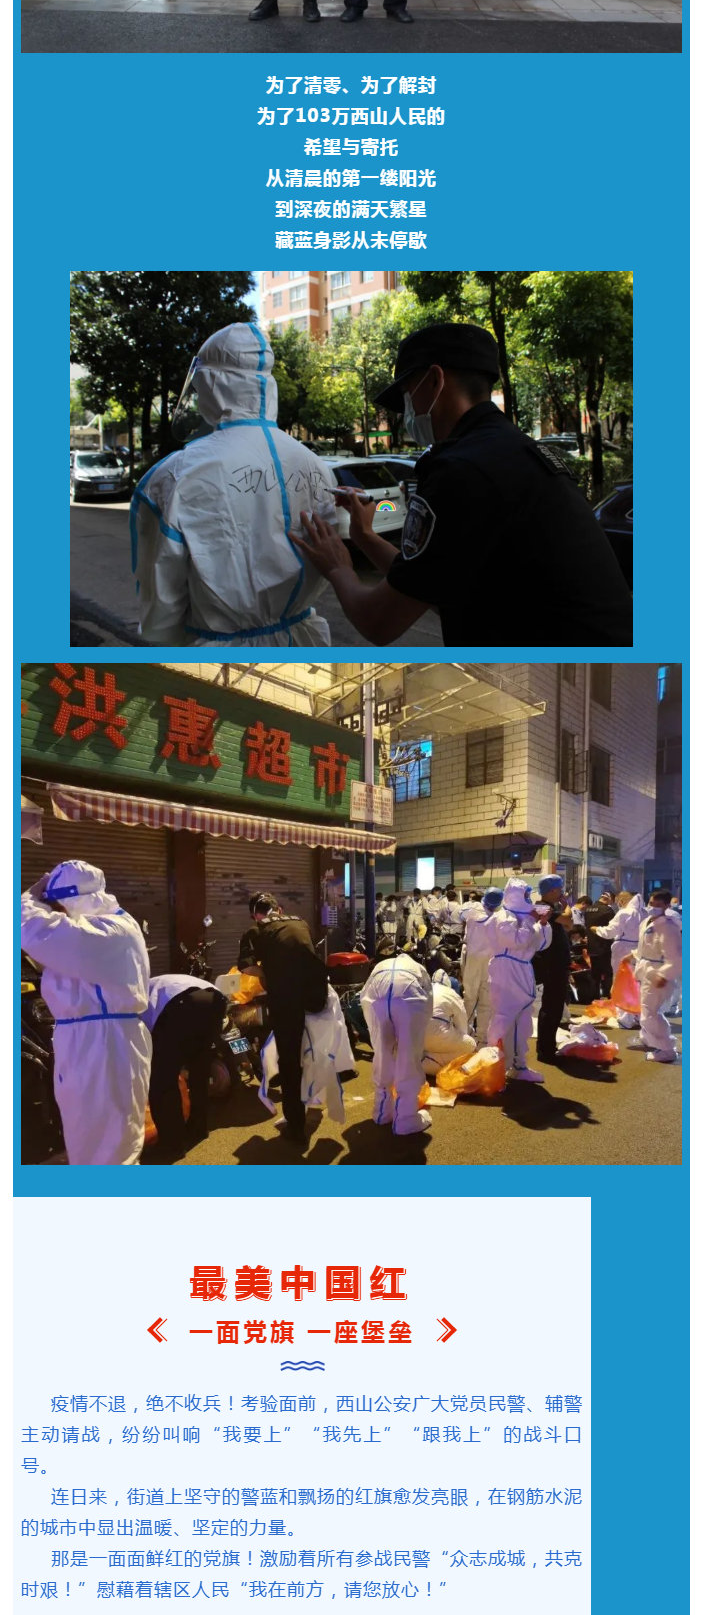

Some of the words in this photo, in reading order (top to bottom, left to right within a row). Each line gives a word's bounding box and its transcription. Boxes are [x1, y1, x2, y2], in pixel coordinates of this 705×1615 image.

[266, 76, 436, 94] 为了清零、为了解封
[258, 107, 444, 125] 为了103万西山人民的
[304, 138, 398, 156] 希望与寄托
[266, 169, 436, 187] 从清晨的第一缕阳光
[275, 200, 426, 218] 到深夜的满天繁星
[275, 231, 427, 249] 藏蓝身影从未停歇
[50, 663, 350, 795] 洪惠超市
[190, 1265, 407, 1301] 最美中国红
[189, 1320, 294, 1344] 一面党旗
[307, 1320, 412, 1344] 一座堡垒
[21, 1458, 46, 1474] 号。
[21, 1519, 293, 1536] 的城市中显出温暖、坚定的力量。
